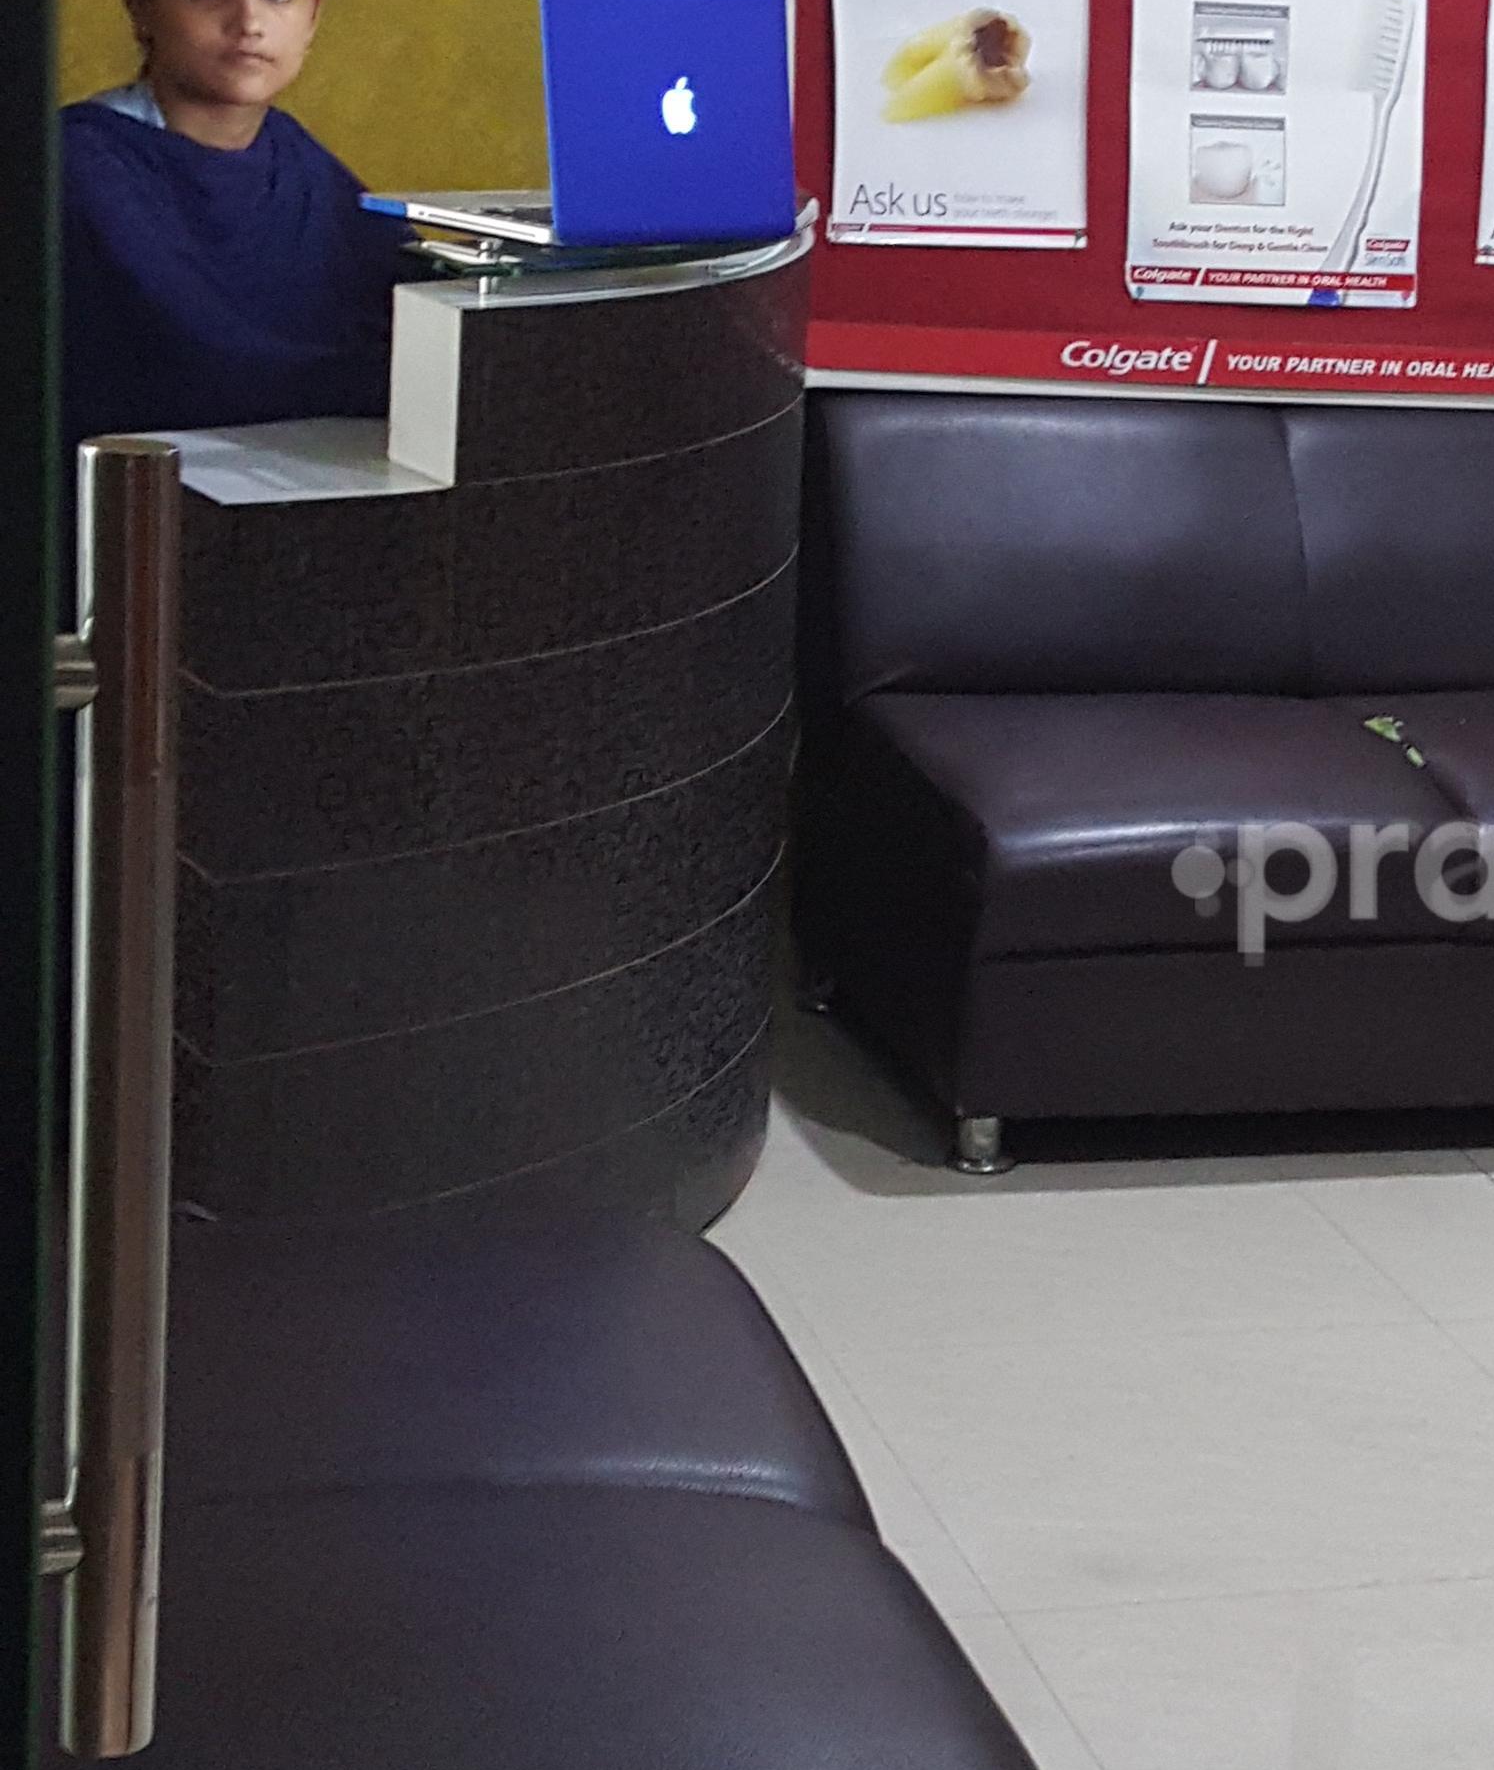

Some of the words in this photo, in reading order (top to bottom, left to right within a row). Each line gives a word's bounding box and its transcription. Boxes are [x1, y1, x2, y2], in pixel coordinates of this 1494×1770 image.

[850, 183, 905, 216] Ask
[913, 192, 948, 217] us
[1133, 266, 1193, 283] Colgate
[1208, 271, 1241, 285] YOUR
[1242, 272, 1297, 287] PARTNER
[1313, 274, 1343, 288] ORAL
[1345, 276, 1388, 289] HEALTH
[1060, 340, 1193, 376] Colgate
[1226, 353, 1281, 373] YOUR
[1283, 356, 1375, 376] PARTNER
[1379, 359, 1402, 376] IN
[1406, 361, 1457, 379] ORAL
